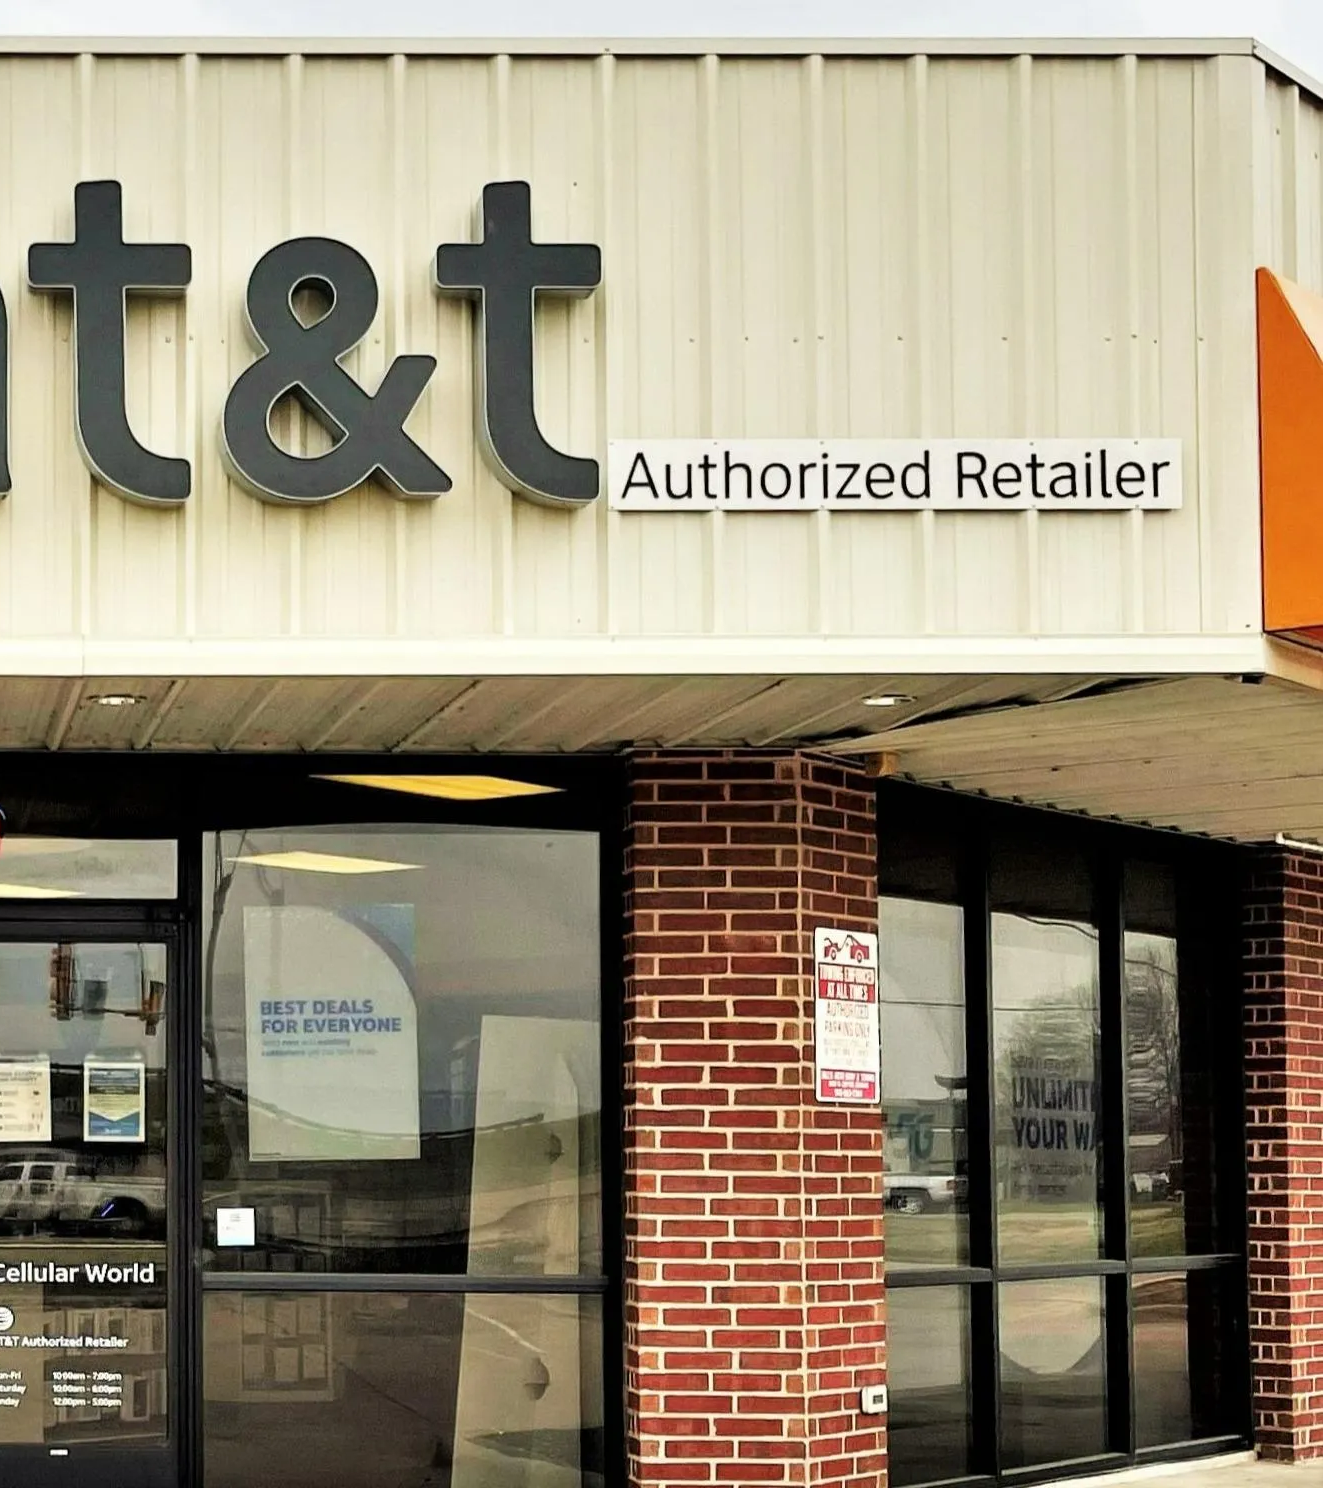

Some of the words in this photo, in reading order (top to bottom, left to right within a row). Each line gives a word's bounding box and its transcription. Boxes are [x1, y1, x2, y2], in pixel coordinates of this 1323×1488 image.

[622, 450, 931, 499] Authorized
[956, 449, 1171, 499] Retailer
[836, 982, 848, 1000] ALL
[260, 1001, 307, 1015] BEST
[313, 1000, 374, 1014] DEALS
[261, 1019, 299, 1033] FOR
[303, 1018, 402, 1033] EVERYONE
[1012, 1116, 1068, 1150] YOUR
[85, 1263, 155, 1283] World
[21, 1336, 83, 1347] Authorized
[85, 1336, 129, 1348] Retailer
